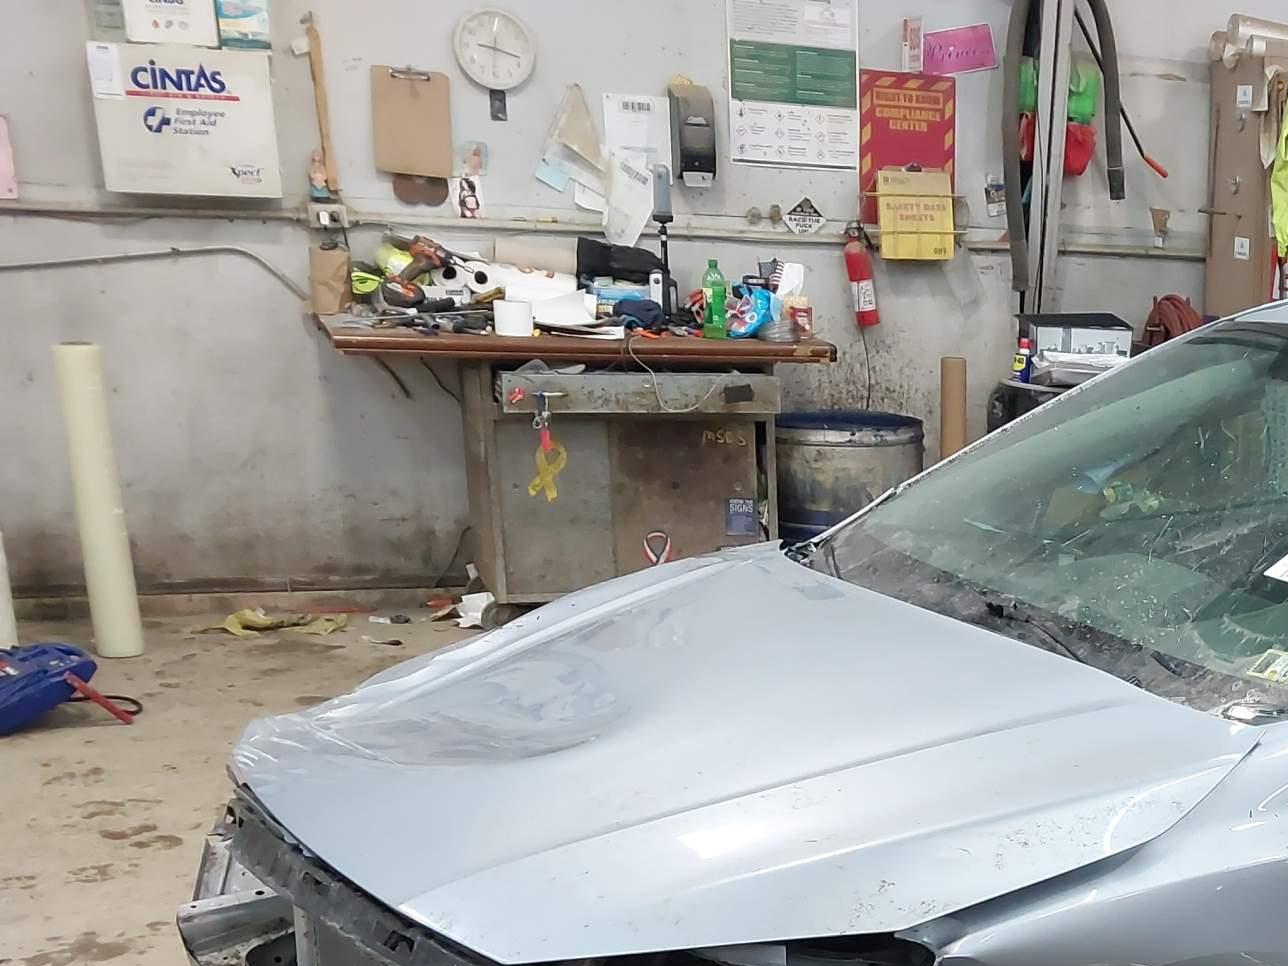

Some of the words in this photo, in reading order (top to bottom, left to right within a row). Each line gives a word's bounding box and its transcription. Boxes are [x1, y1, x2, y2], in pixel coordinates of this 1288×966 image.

[130, 59, 226, 93] CINTAS
[175, 107, 226, 119] Employee
[174, 118, 196, 126] First
[199, 118, 217, 127] Aid
[889, 119, 928, 132] CENTER
[173, 126, 210, 136] Station
[729, 503, 754, 513] SIGNS
